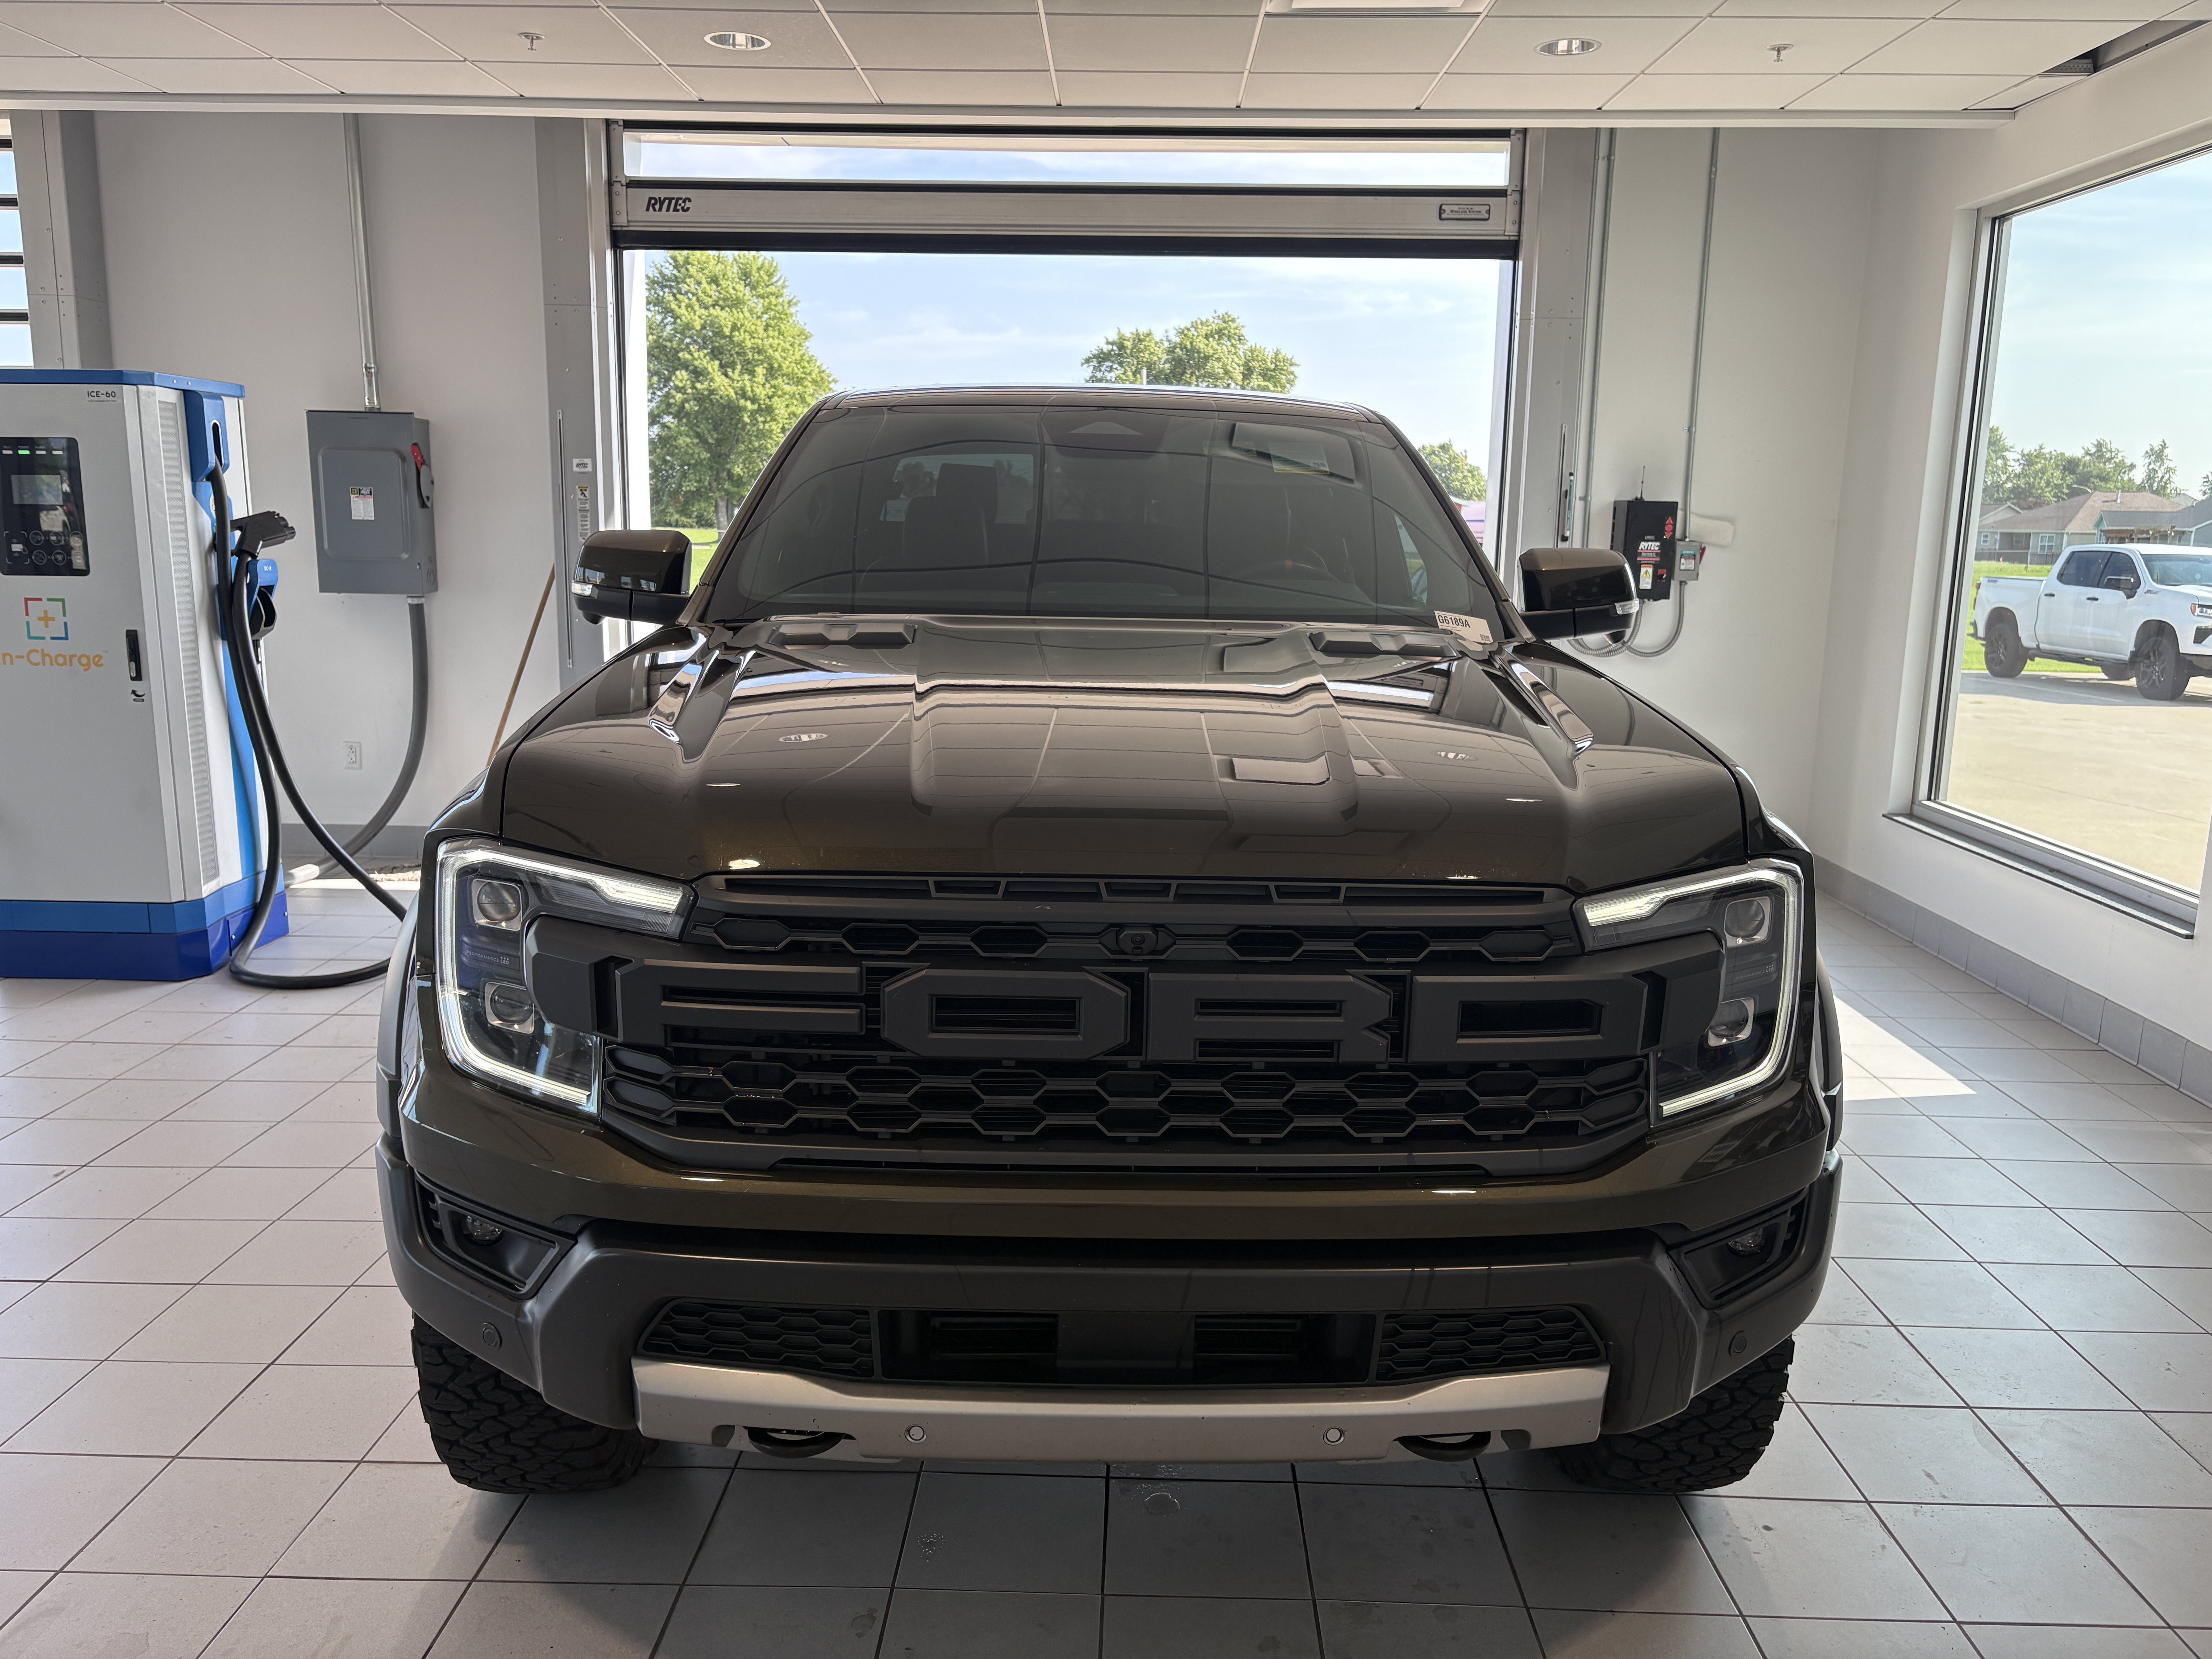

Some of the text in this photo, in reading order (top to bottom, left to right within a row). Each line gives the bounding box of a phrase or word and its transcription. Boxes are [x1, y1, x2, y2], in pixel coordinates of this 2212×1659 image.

[645, 197, 692, 212] RYTEC
[1639, 541, 1661, 550] RYTEC
[1438, 615, 1471, 628] G6189A
[0, 648, 104, 672] n-Charge
[617, 960, 1649, 1063] FORD
